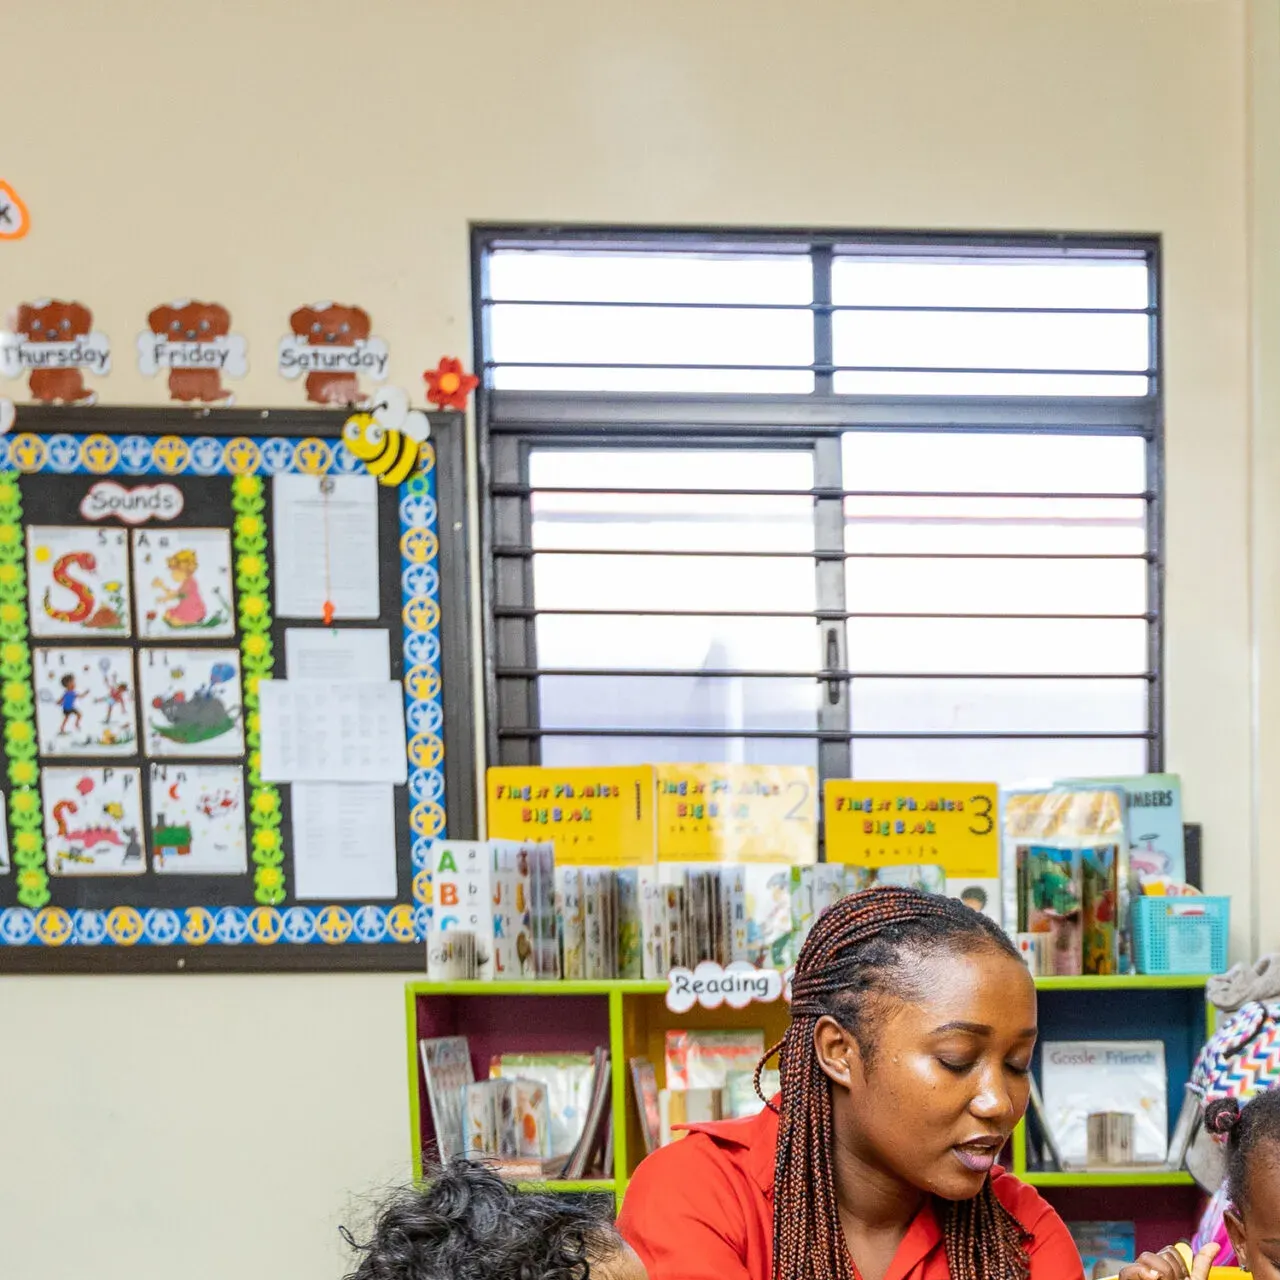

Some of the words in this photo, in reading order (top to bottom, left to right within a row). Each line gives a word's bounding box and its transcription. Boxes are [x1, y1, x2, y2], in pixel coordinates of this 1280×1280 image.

[4, 343, 110, 368] Thursday
[154, 343, 230, 368] Friday
[280, 346, 388, 374] Saturday
[91, 491, 175, 511] Sounds
[656, 780, 705, 796] inger
[712, 780, 779, 797] Phnics
[784, 780, 809, 821] 2
[969, 794, 993, 835] 3
[437, 850, 458, 873] A
[468, 850, 476, 859] a
[440, 882, 459, 906] B
[468, 881, 477, 895] b
[470, 914, 477, 924] c
[675, 974, 769, 997] Reading
